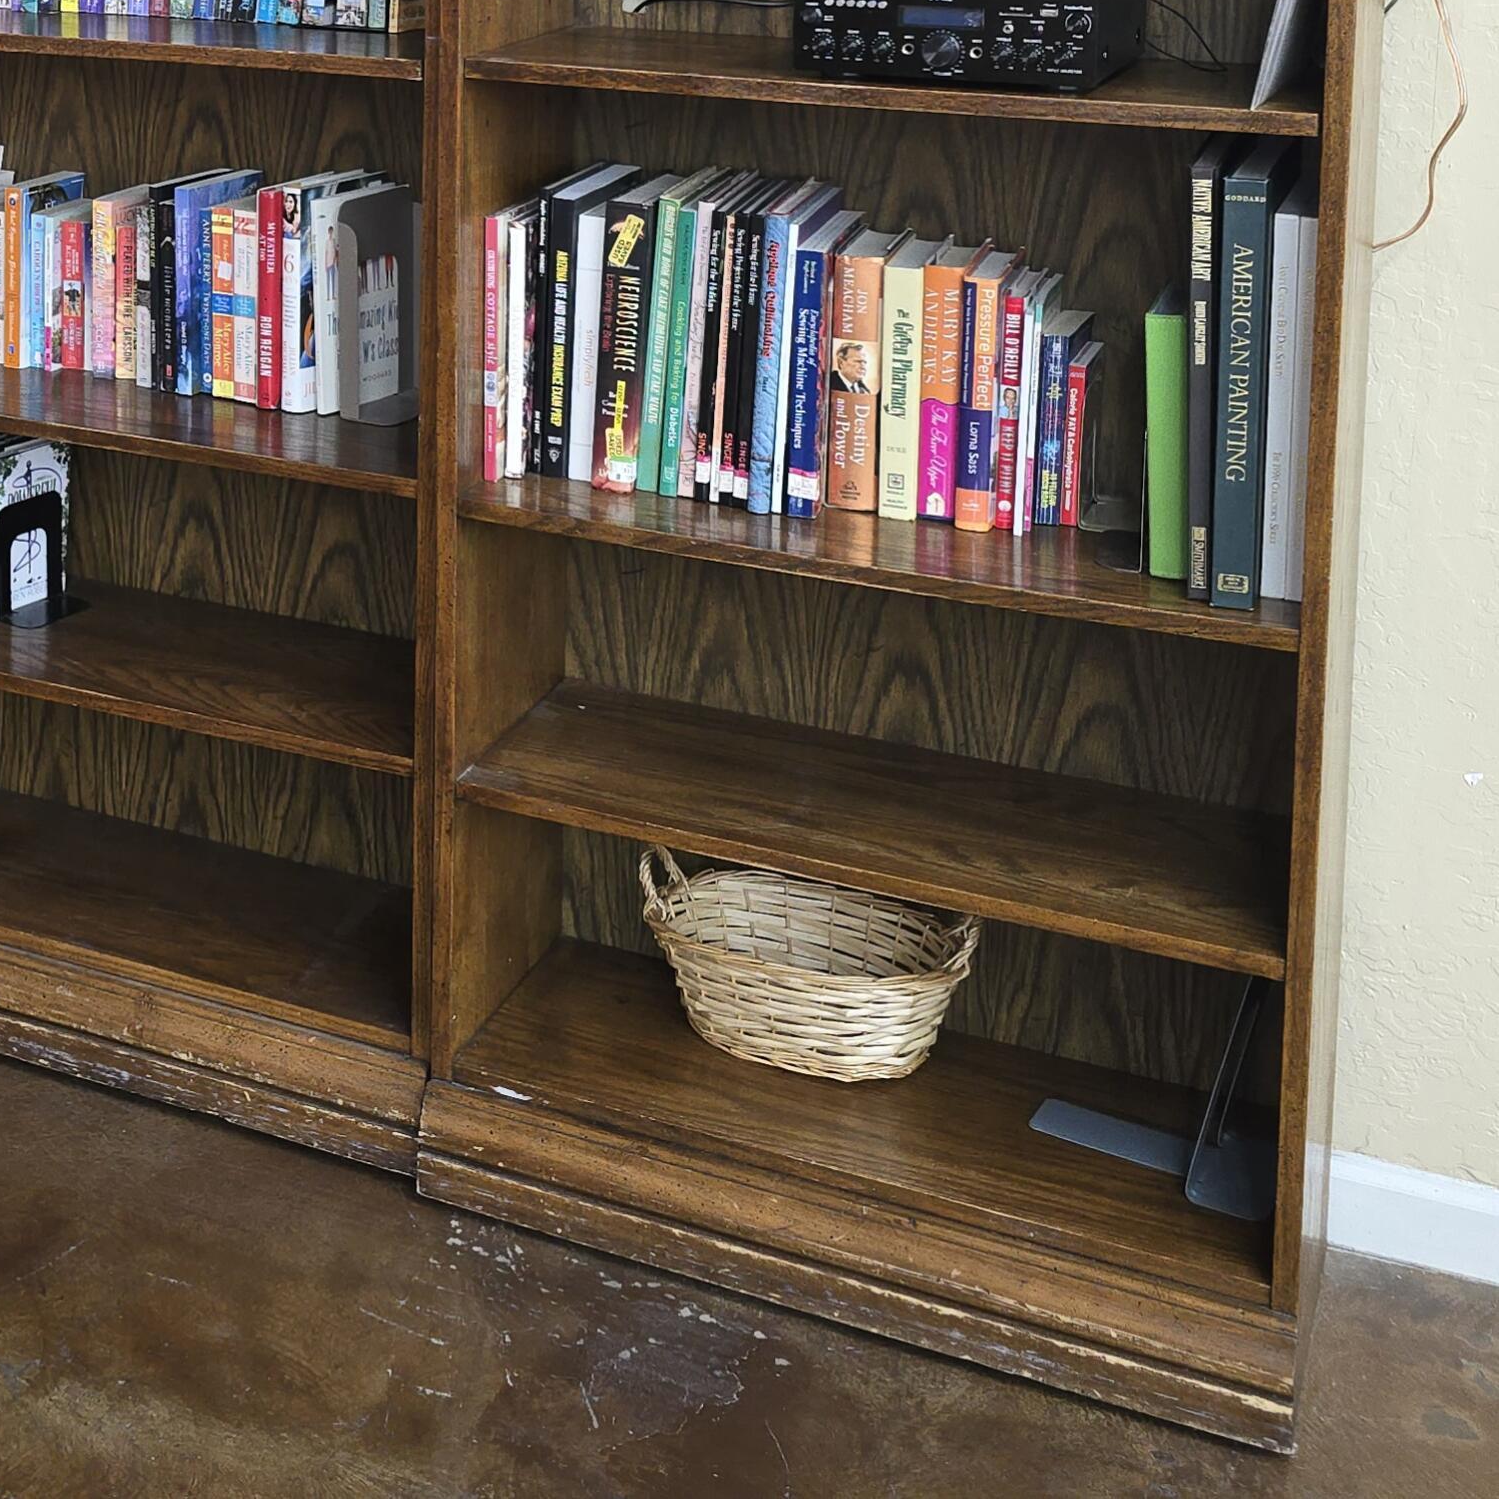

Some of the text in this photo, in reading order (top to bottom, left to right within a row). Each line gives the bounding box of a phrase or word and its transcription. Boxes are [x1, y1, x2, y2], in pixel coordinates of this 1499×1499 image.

[202, 219, 211, 248] ANNE
[1192, 178, 1213, 281] NATIVE AMERICAN ART
[202, 252, 212, 284] PERRY
[266, 238, 275, 274] FATHER
[123, 277, 132, 299] WITH
[123, 300, 132, 318] FIRE
[842, 266, 856, 333] MEACHAM
[856, 288, 868, 314] JON
[487, 292, 496, 339] COTTAGE
[550, 250, 569, 427] ARIZONA LIFE AND HEALTH INSURANCE EXAM PREP
[613, 275, 640, 372] NEUROSCIENCE
[923, 288, 938, 386] ANDREWS
[941, 288, 959, 386] MARY KAY
[1005, 313, 1021, 335] BILL
[122, 327, 132, 362] LARSSON
[213, 328, 222, 367] Monroe
[221, 323, 232, 375] Mary Alice
[260, 316, 272, 377] RON REAGAN
[807, 356, 816, 366] of
[975, 288, 994, 409] Pressure Perfect
[1003, 337, 1020, 381] O'REILLY
[1224, 243, 1255, 482] AMERICAN PAINTING
[667, 300, 686, 448] Cooking and Baking for Diabetics
[791, 308, 809, 449] Sewing Machine Techniques
[884, 322, 914, 420] Green Pharmacy
[834, 398, 851, 469] and Power
[852, 404, 870, 466] Destiny
[968, 421, 980, 474] Lorna Sass
[1001, 451, 1014, 462] IT
[1002, 426, 1016, 449] KEEP
[929, 456, 947, 489] Upper
